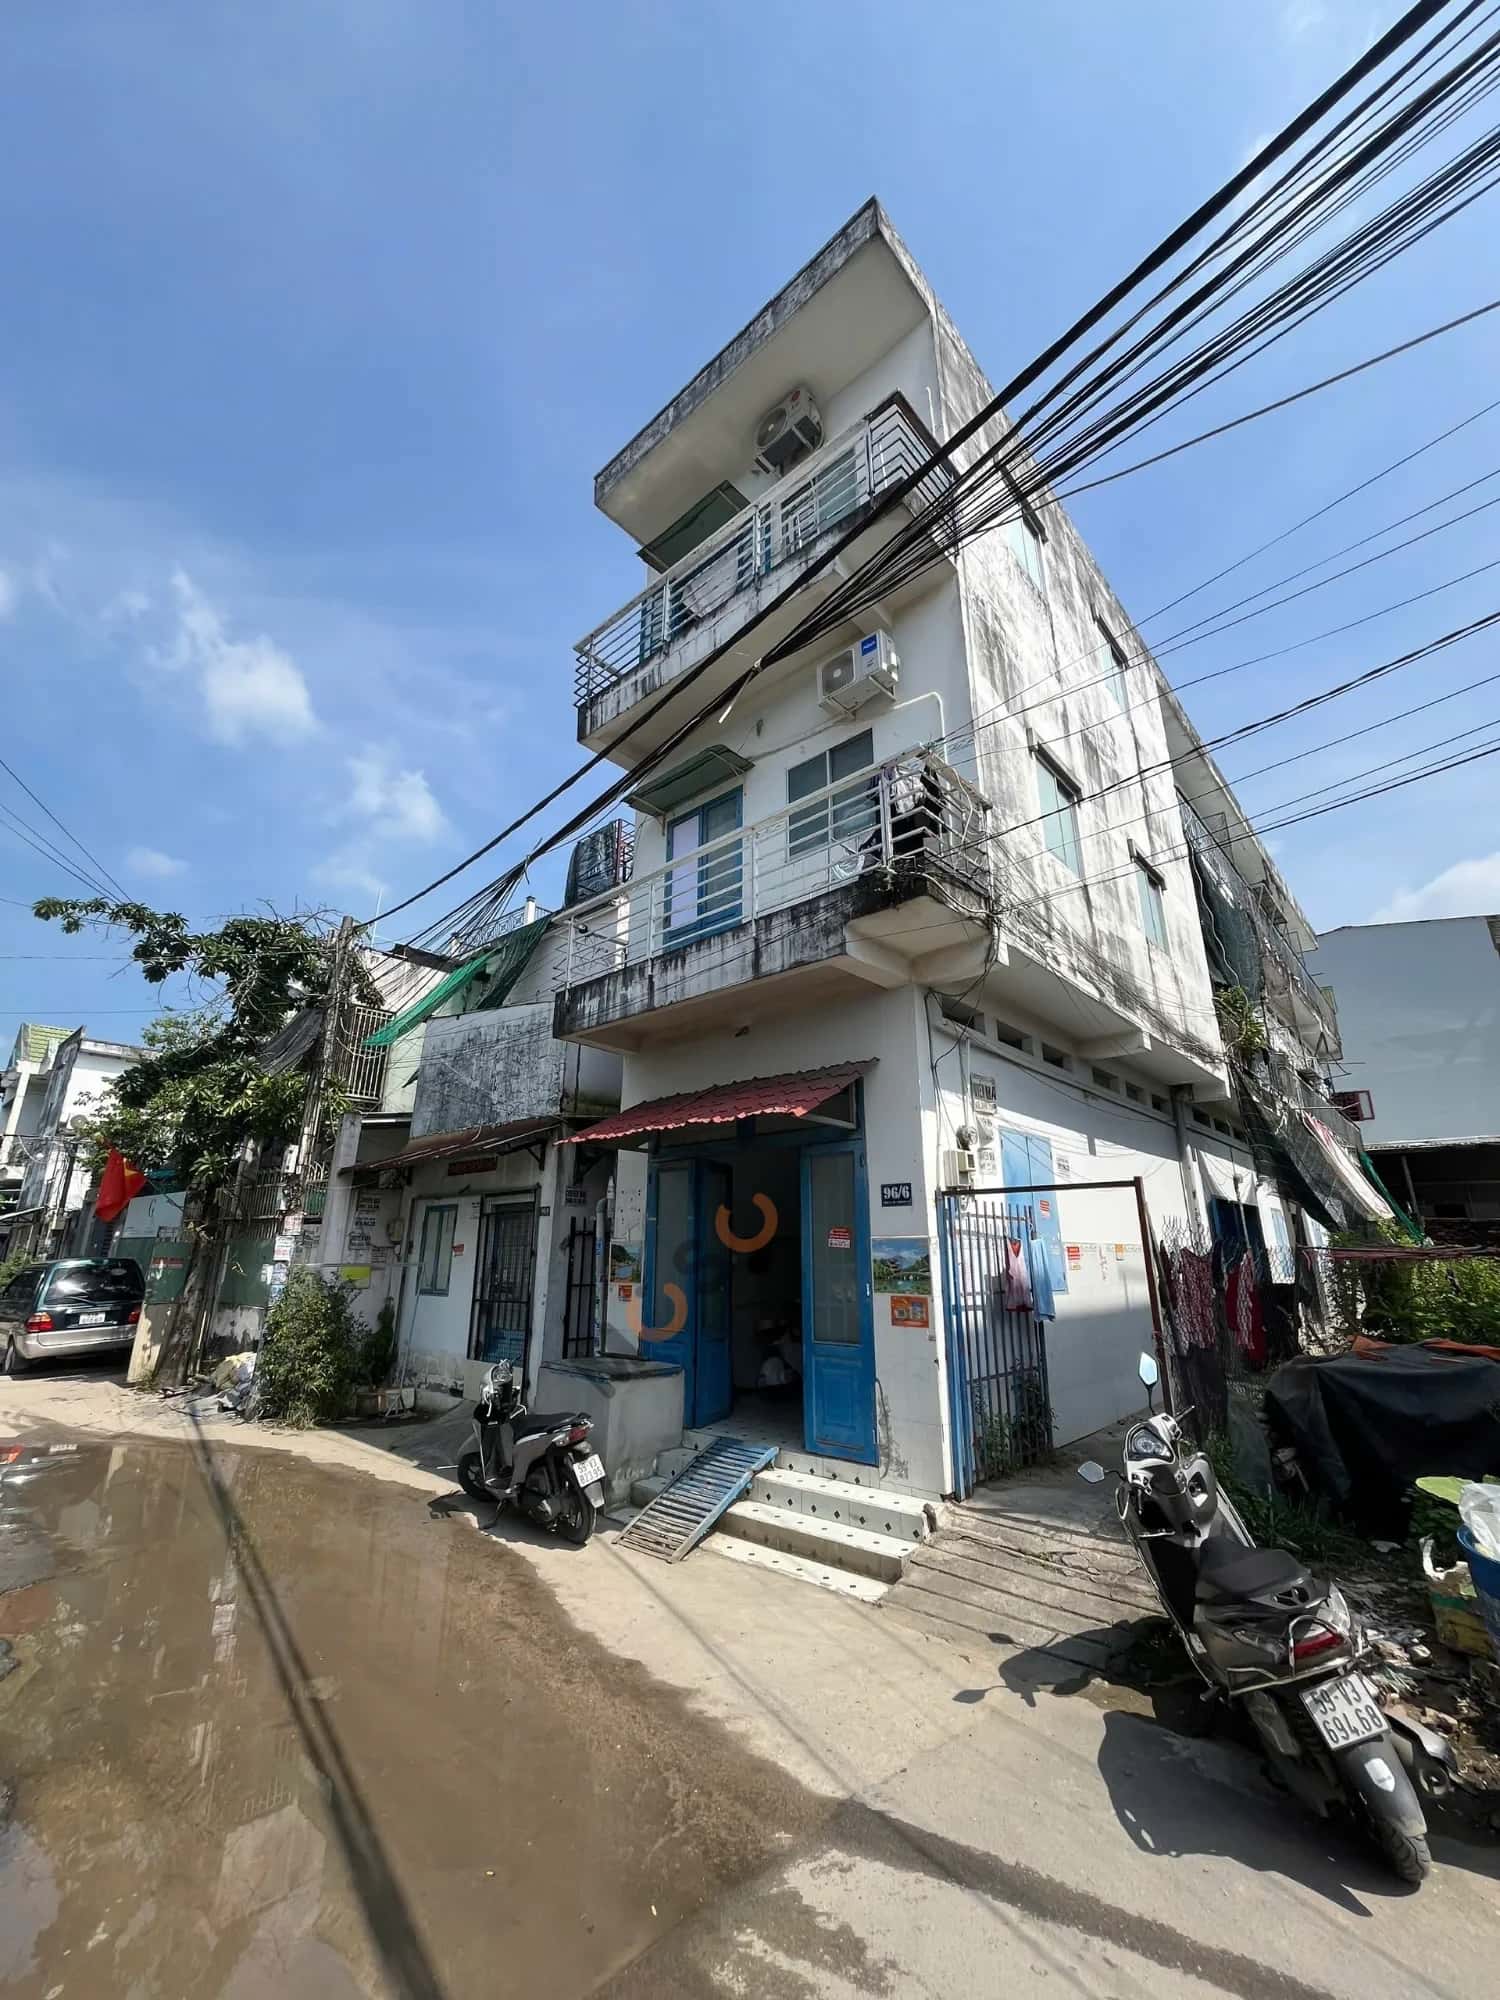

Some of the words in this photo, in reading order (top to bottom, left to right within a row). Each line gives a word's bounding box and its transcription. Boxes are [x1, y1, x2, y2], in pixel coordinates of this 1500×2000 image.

[883, 1185, 910, 1200] 96/6
[1310, 1680, 1361, 1715] 59-V3
[1323, 1704, 1383, 1744] 694.68
